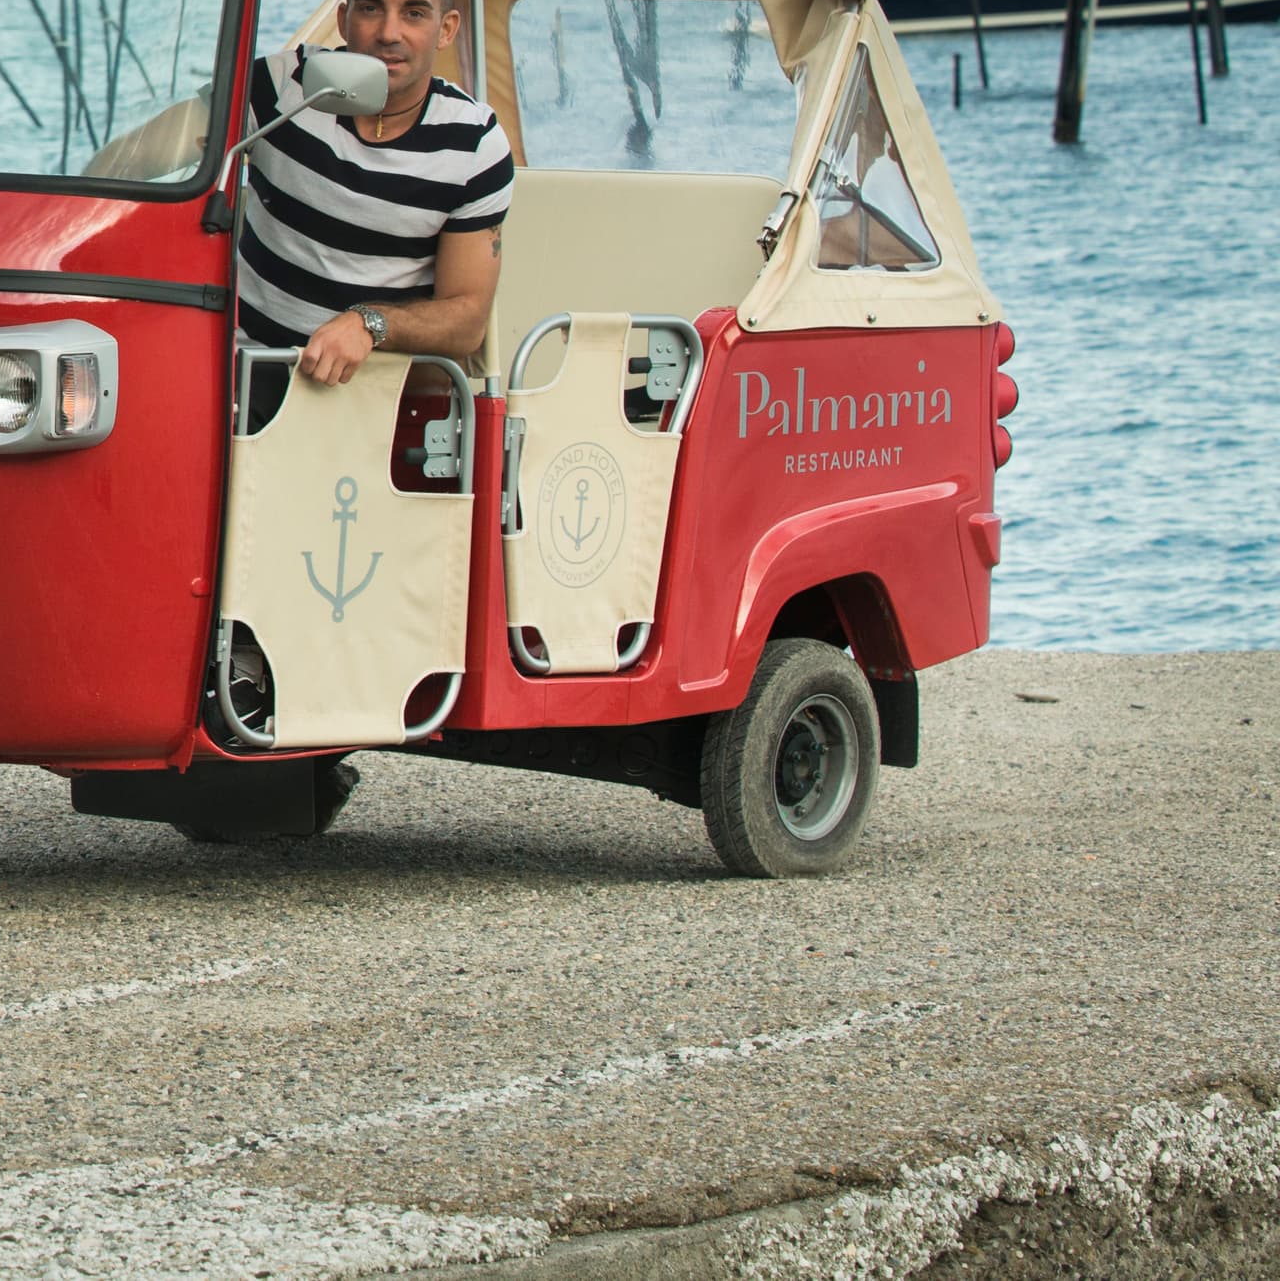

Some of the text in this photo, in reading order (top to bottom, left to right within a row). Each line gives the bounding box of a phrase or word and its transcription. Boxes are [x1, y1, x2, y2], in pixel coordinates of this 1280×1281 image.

[732, 359, 952, 438] Palmaria
[542, 449, 624, 505] GRAND HOTEL
[785, 446, 903, 474] RESTAURANT
